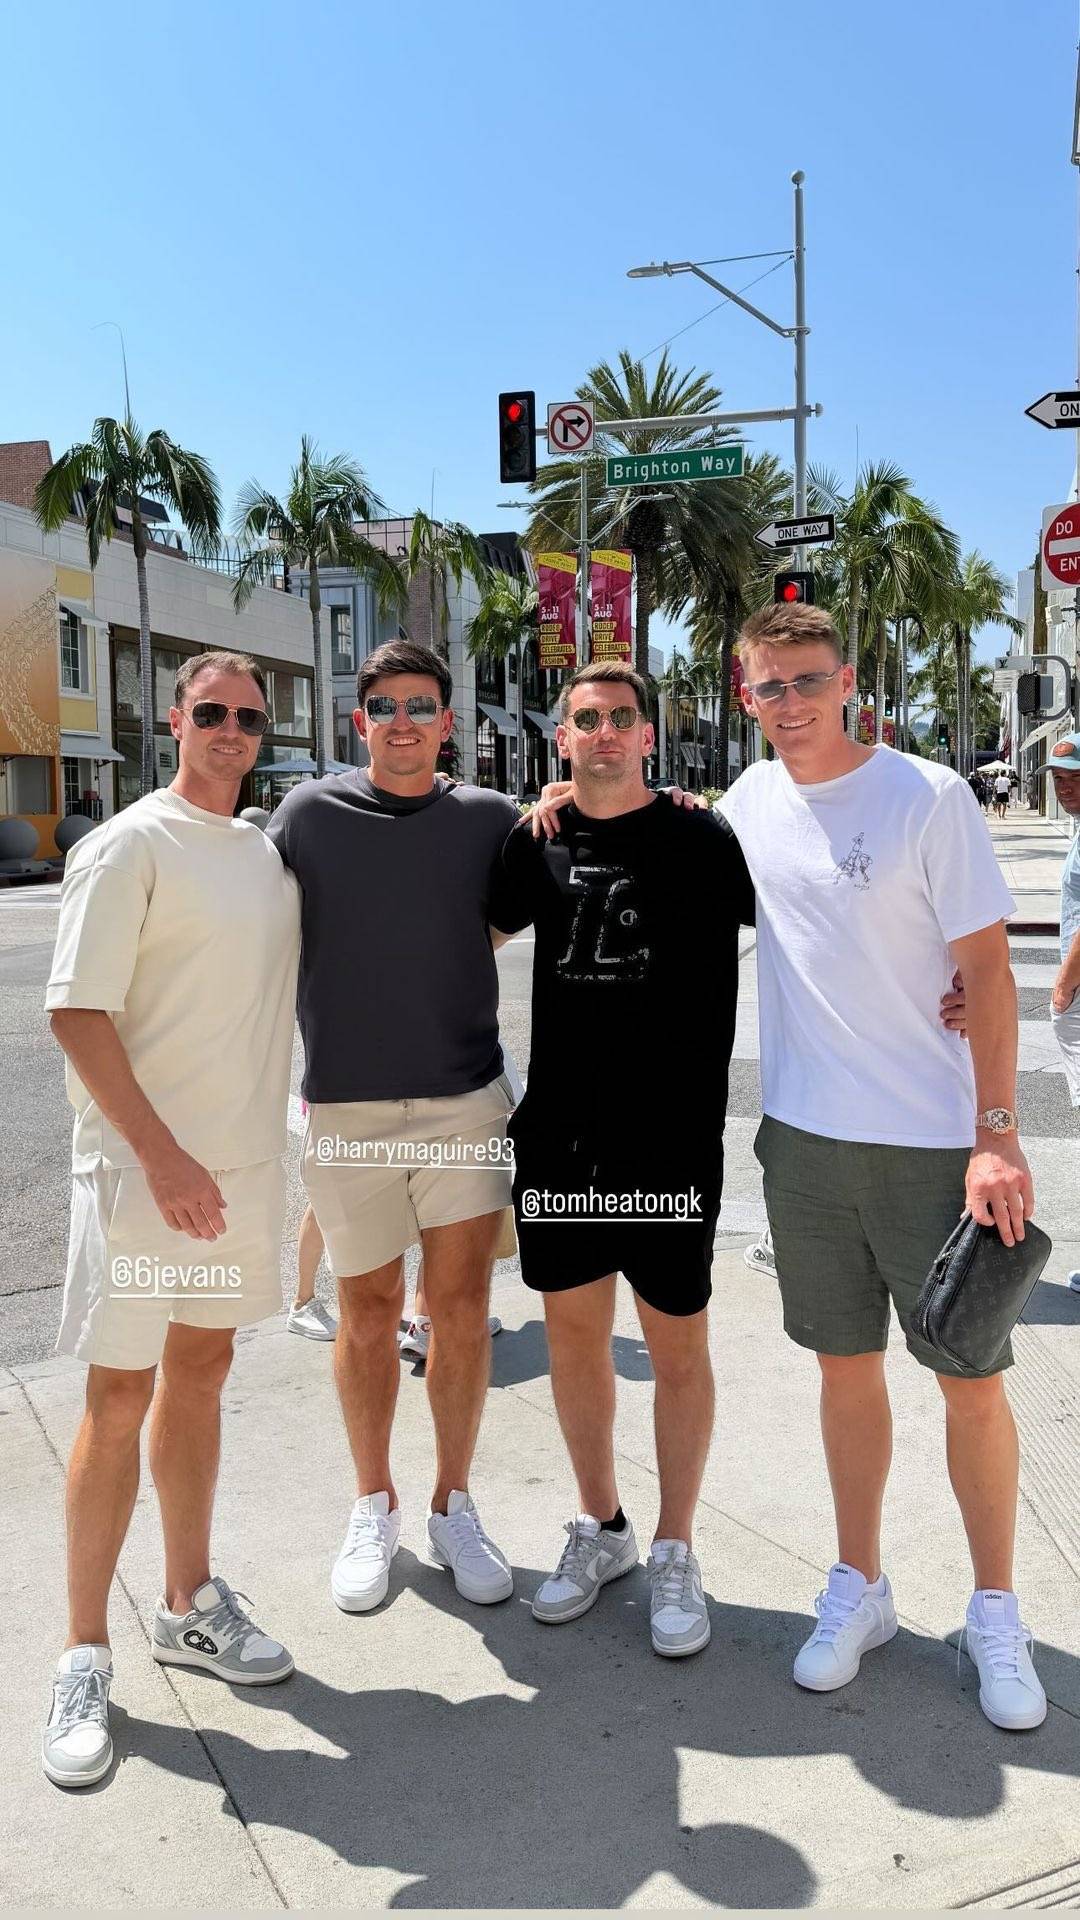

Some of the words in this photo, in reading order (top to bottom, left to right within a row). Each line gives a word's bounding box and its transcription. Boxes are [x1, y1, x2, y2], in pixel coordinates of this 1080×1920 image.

[613, 460, 690, 482] Brighton
[701, 456, 736, 473] Way
[777, 527, 798, 539] ONE
[803, 523, 824, 536] WAY
[1056, 520, 1073, 536] DO
[541, 612, 559, 620] AUG
[594, 610, 612, 618] AUG
[594, 622, 614, 630] RODEO
[541, 635, 558, 643] DRIVE
[594, 632, 612, 640] DRIVE
[594, 643, 628, 651] CELEBRATES
[541, 657, 565, 665] FASHION
